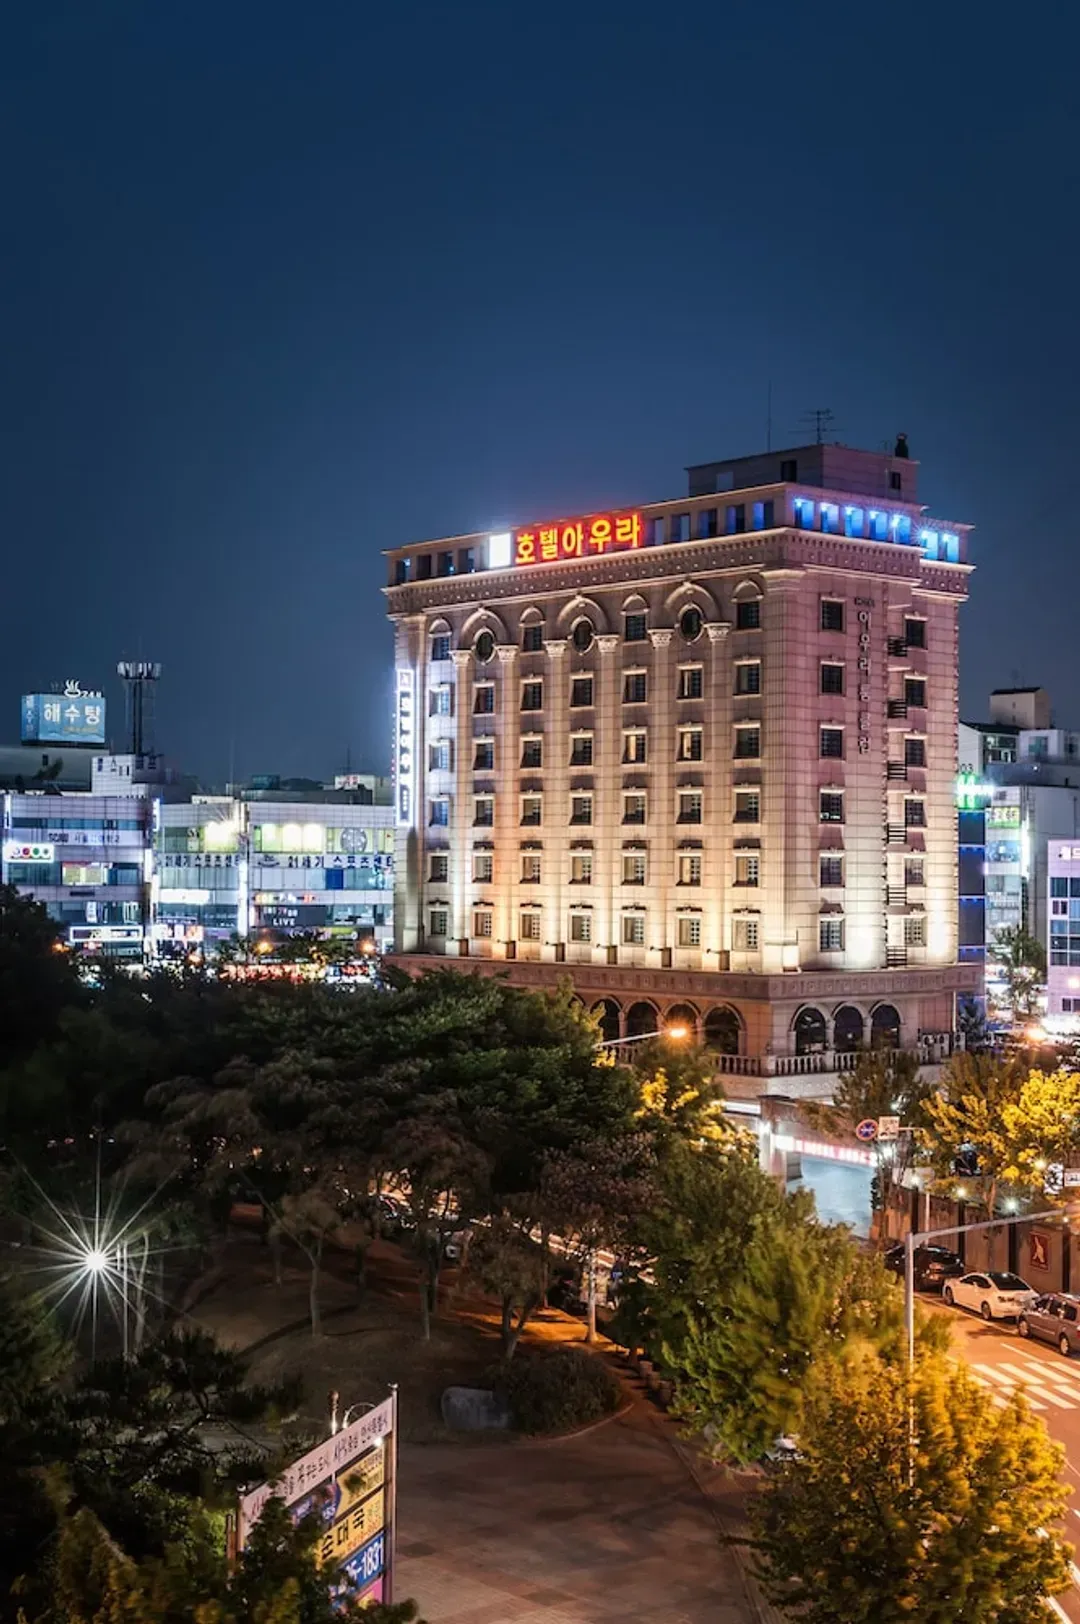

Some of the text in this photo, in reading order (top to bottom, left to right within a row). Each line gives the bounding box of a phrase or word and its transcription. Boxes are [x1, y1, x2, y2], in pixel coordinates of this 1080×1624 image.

[515, 514, 641, 565] 호텔아우라
[43, 703, 101, 725] 해수탕
[273, 918, 296, 926] LIVE
